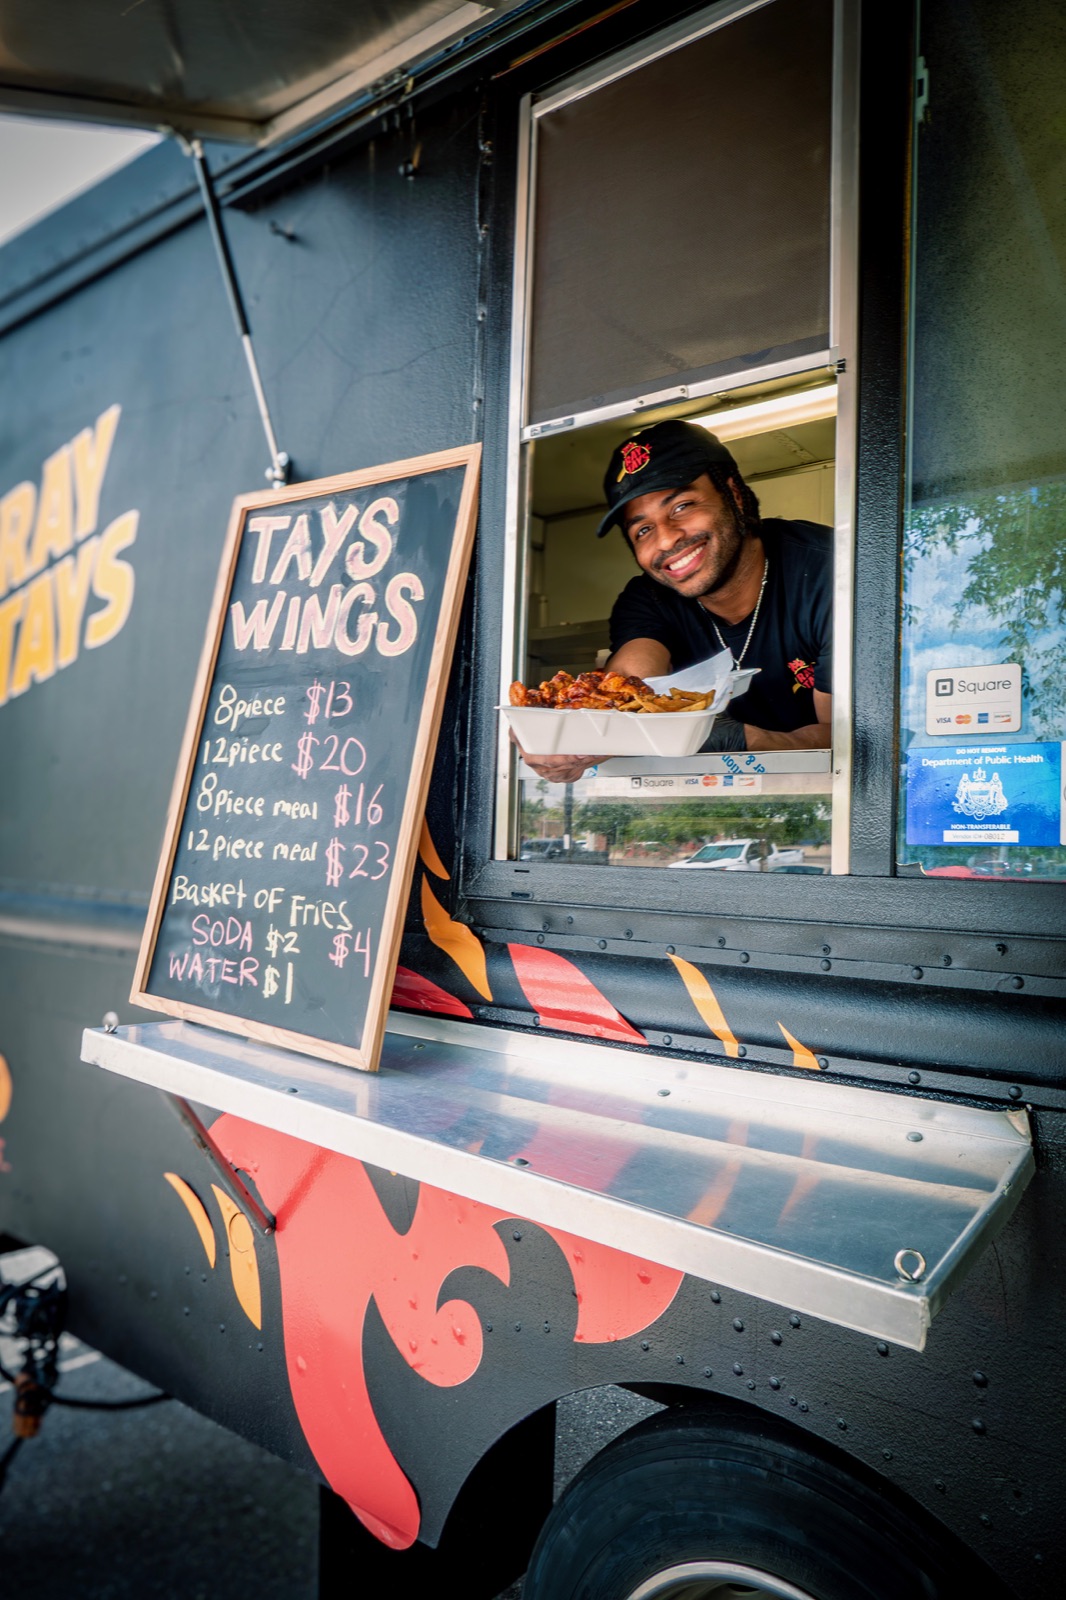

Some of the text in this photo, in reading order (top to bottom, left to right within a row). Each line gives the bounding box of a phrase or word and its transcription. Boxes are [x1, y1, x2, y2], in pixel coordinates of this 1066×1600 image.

[248, 496, 399, 587] TAYS
[231, 572, 424, 656] WINGS
[304, 678, 353, 725] $13
[957, 679, 1012, 694] Square
[291, 731, 367, 780] $20
[922, 754, 1044, 768] Department of Public Health
[272, 800, 318, 820] meal
[333, 783, 384, 828] $16
[643, 778, 674, 787] Square
[272, 842, 318, 861] meal
[325, 837, 390, 887] $23
[172, 875, 247, 909] Basket
[289, 895, 353, 931] Fries
[191, 914, 301, 958] SODA $2
[328, 927, 371, 978] $4
[169, 952, 294, 1004] WATER $1
